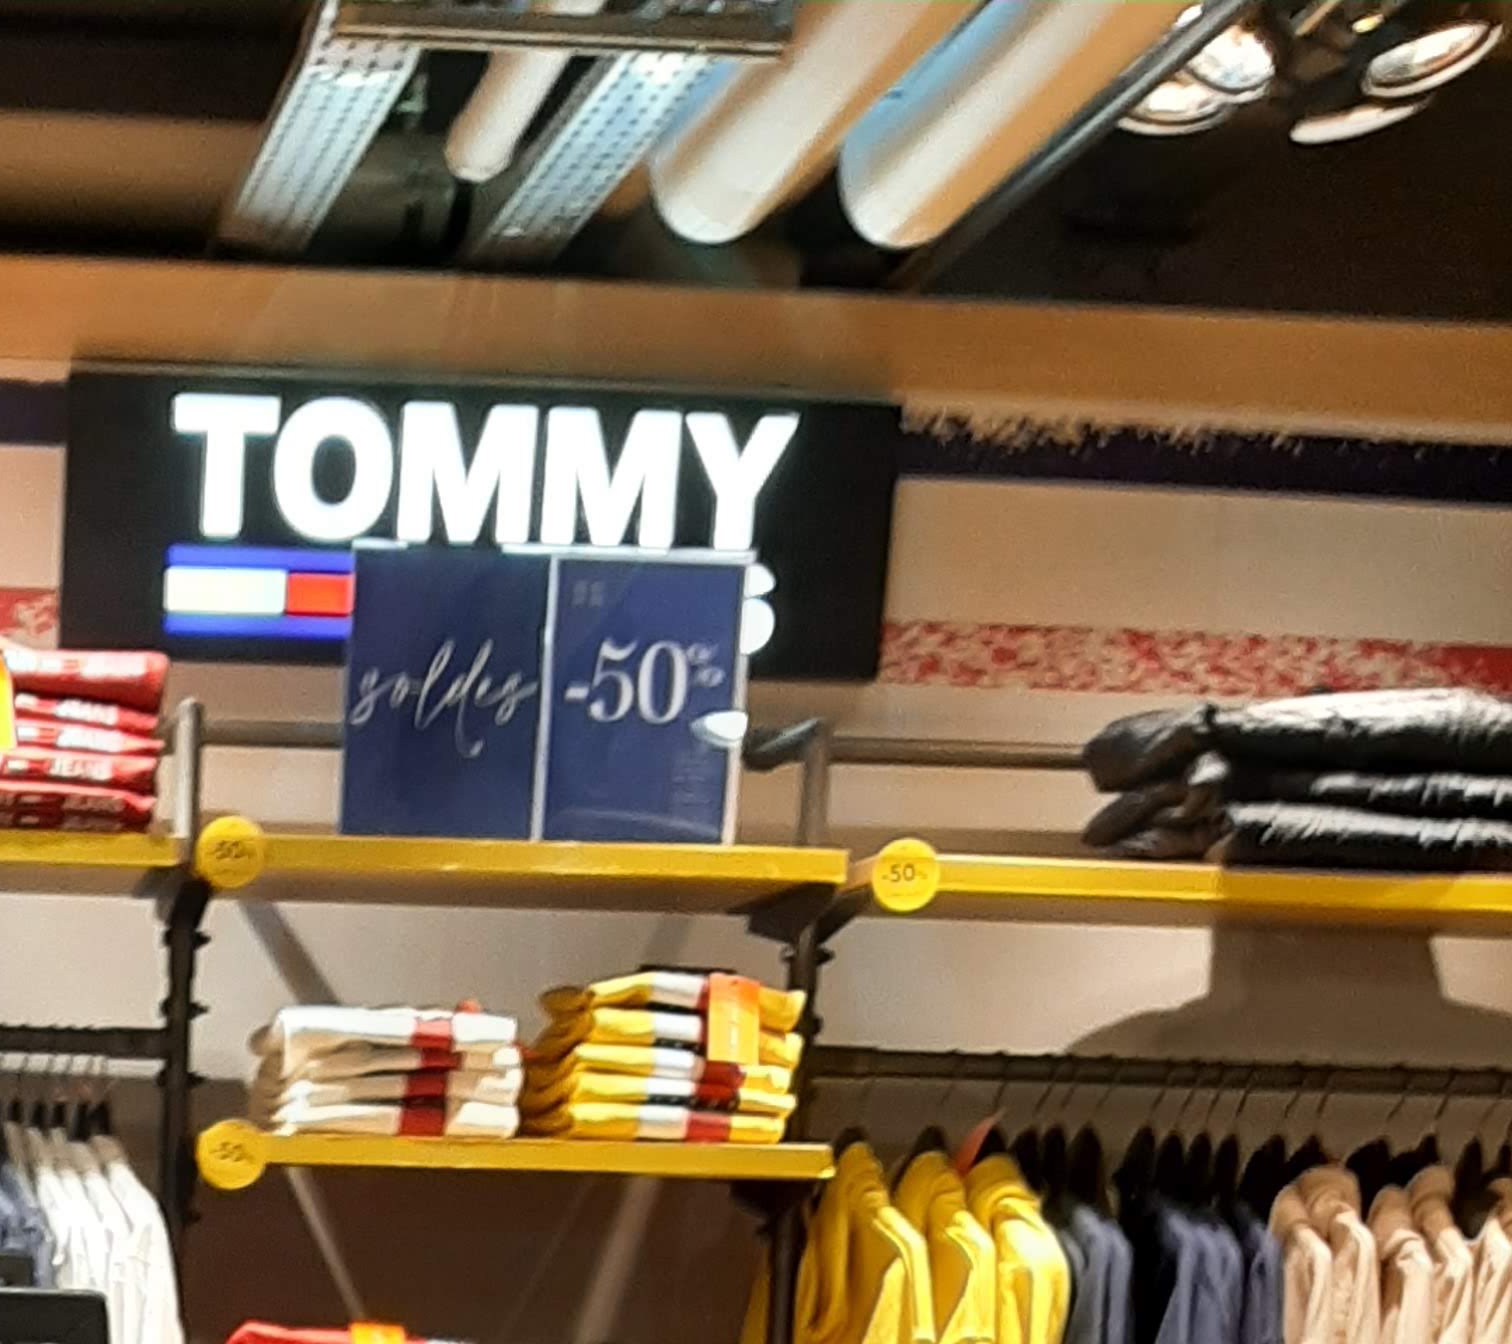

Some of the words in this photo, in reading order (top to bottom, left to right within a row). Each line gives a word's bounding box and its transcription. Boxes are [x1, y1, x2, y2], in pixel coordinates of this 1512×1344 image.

[171, 392, 800, 551] TOMMY
[349, 637, 538, 759] soldes
[565, 637, 726, 725] -50%
